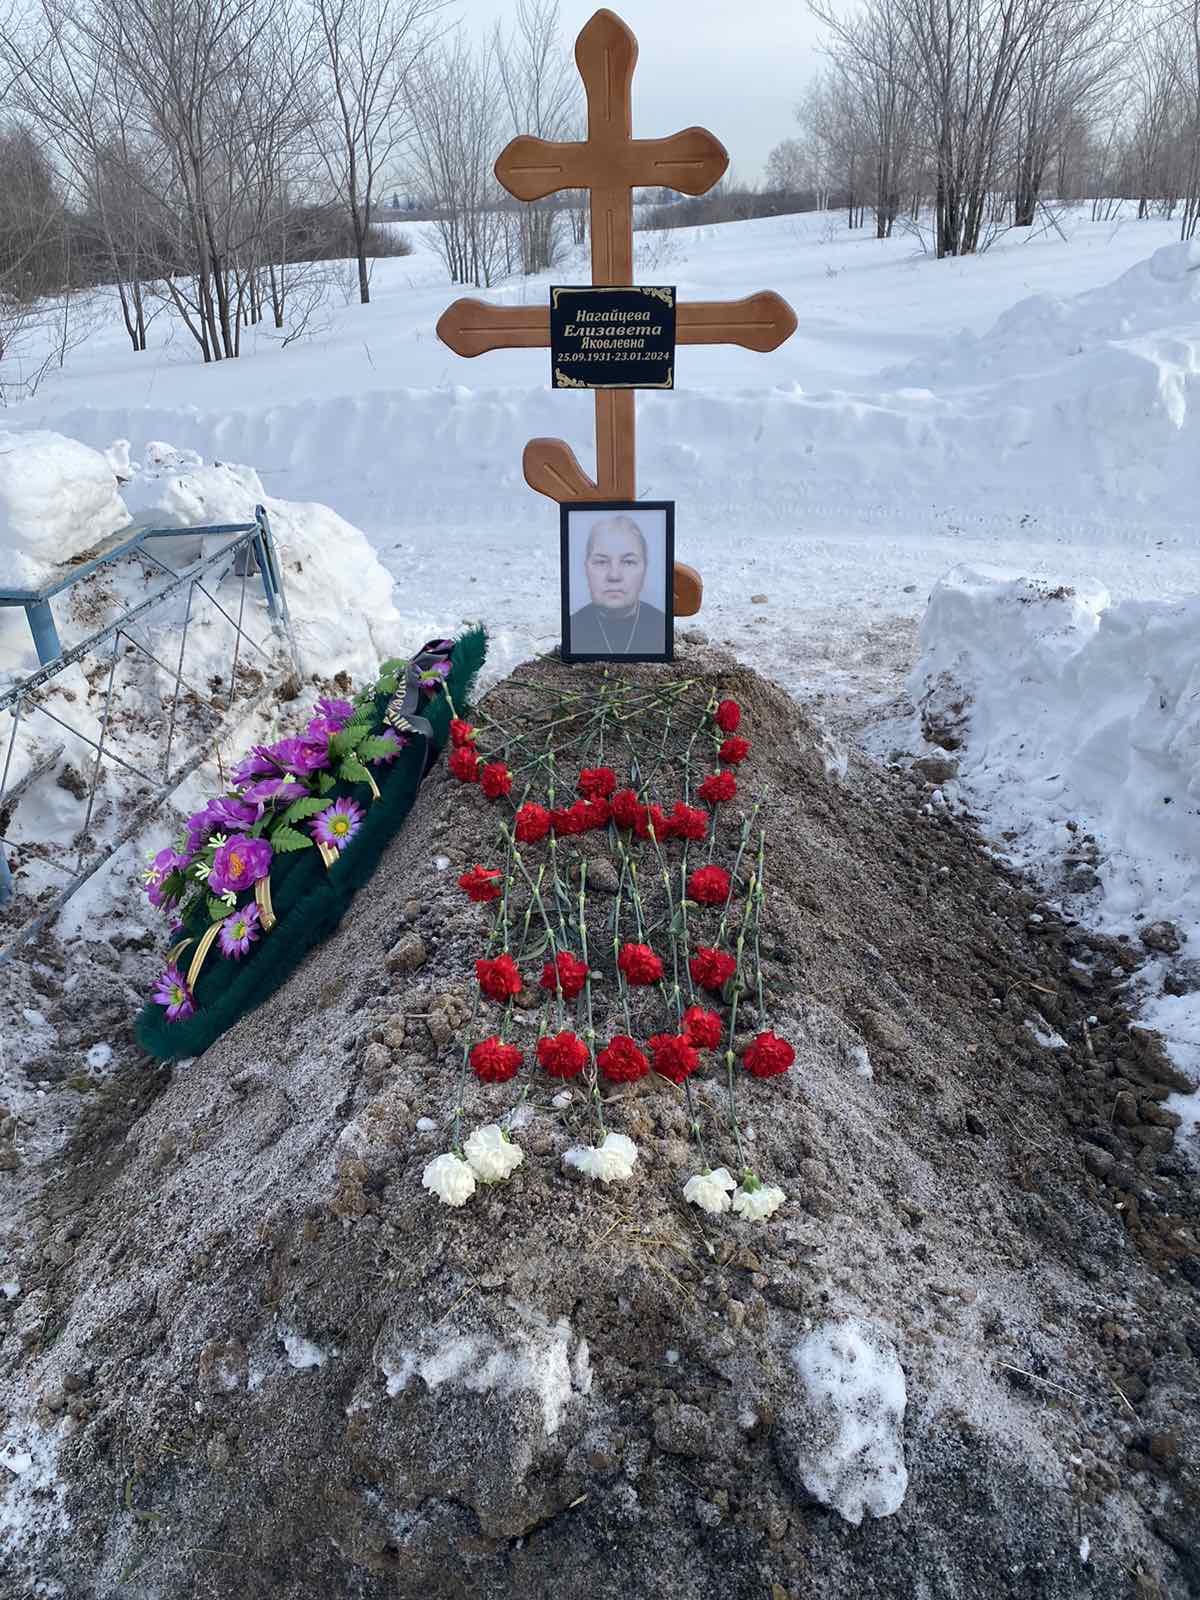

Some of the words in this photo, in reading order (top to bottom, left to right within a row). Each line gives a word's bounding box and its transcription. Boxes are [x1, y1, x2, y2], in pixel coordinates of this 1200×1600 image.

[576, 309, 651, 324] Нагайцева
[564, 324, 663, 337] Елизавета
[581, 337, 645, 349] Яковлевна
